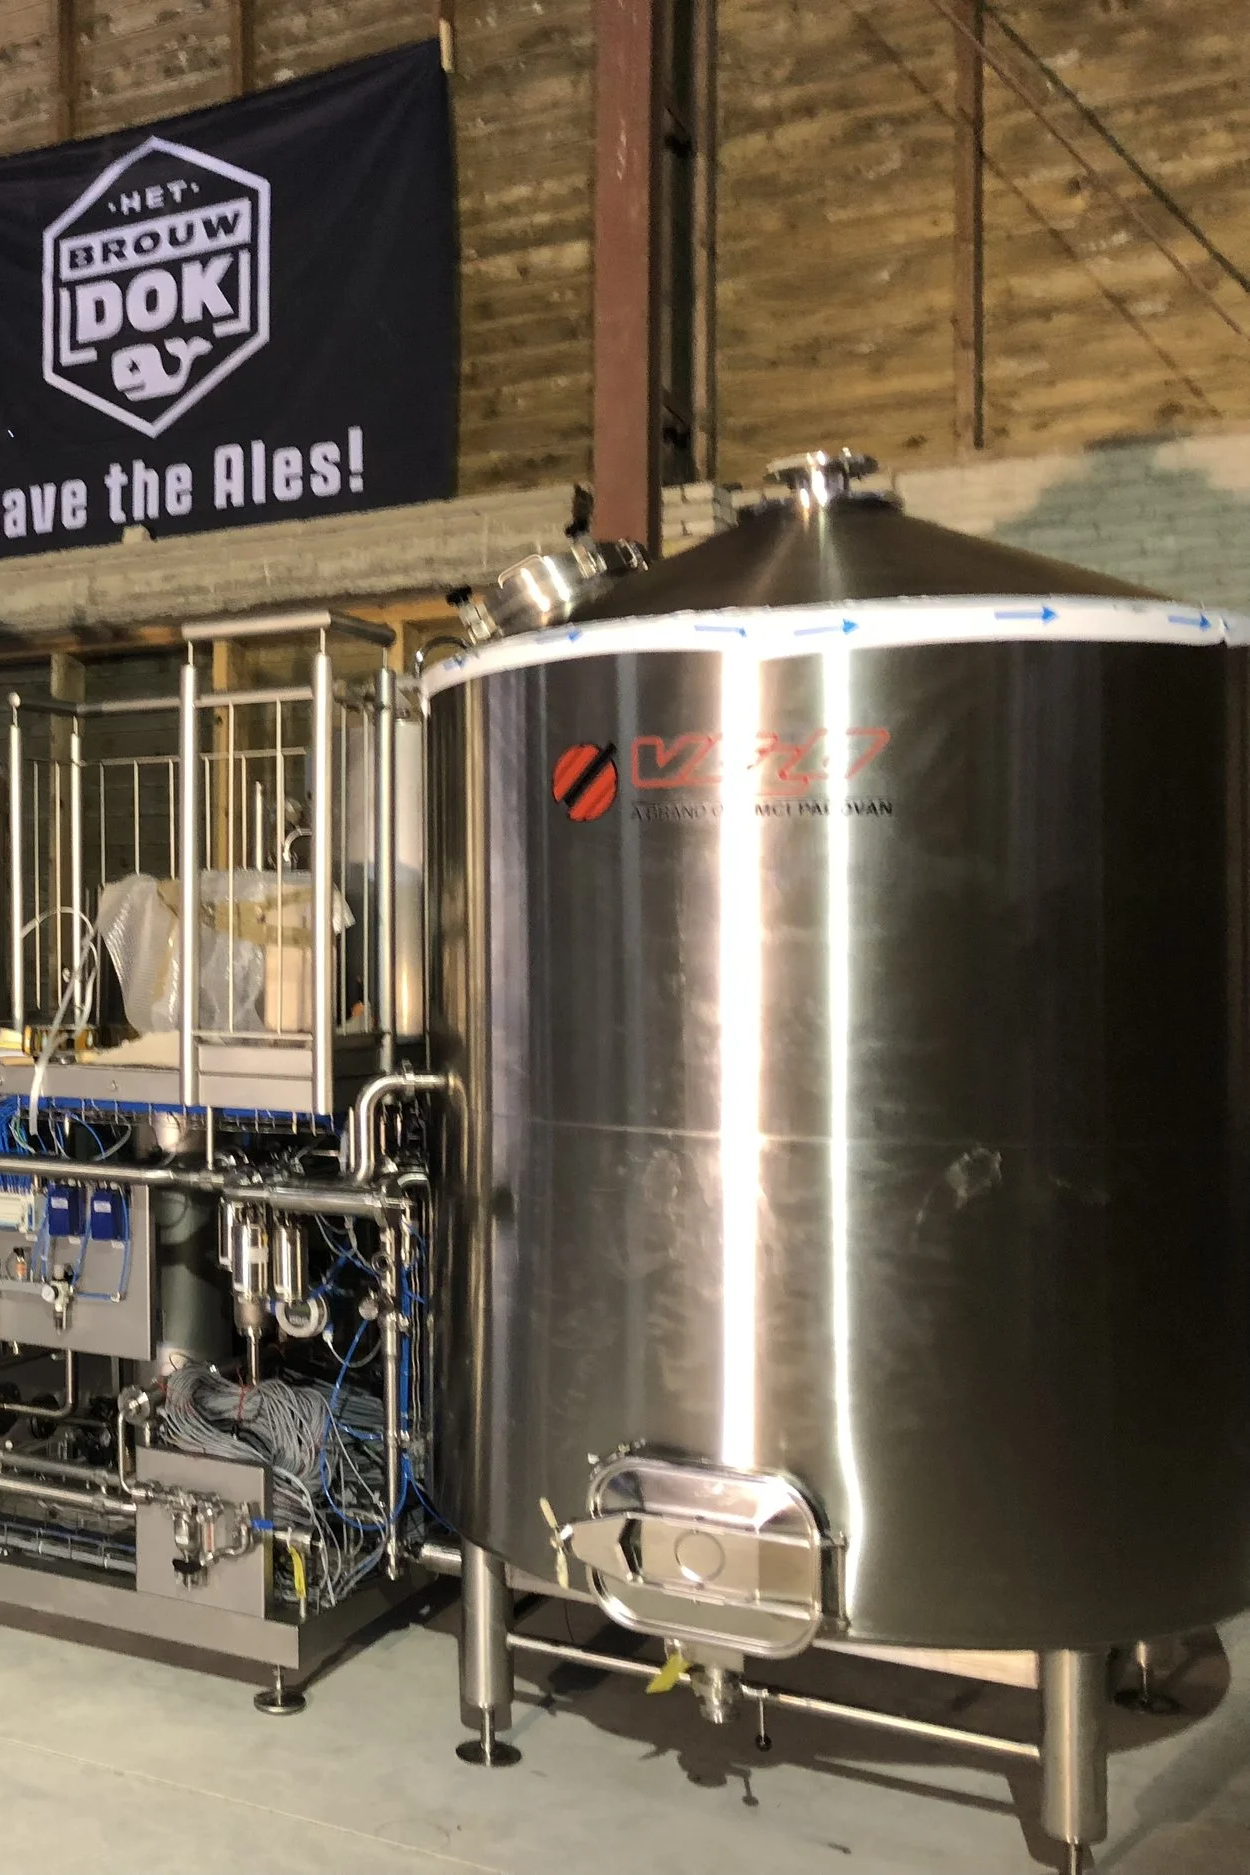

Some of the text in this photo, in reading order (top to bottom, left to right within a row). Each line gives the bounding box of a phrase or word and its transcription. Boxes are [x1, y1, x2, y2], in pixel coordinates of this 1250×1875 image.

[120, 178, 189, 215] HET
[67, 209, 243, 270] BROUW
[76, 253, 235, 345] DOK
[103, 458, 193, 526] the
[213, 425, 364, 510] Ales!
